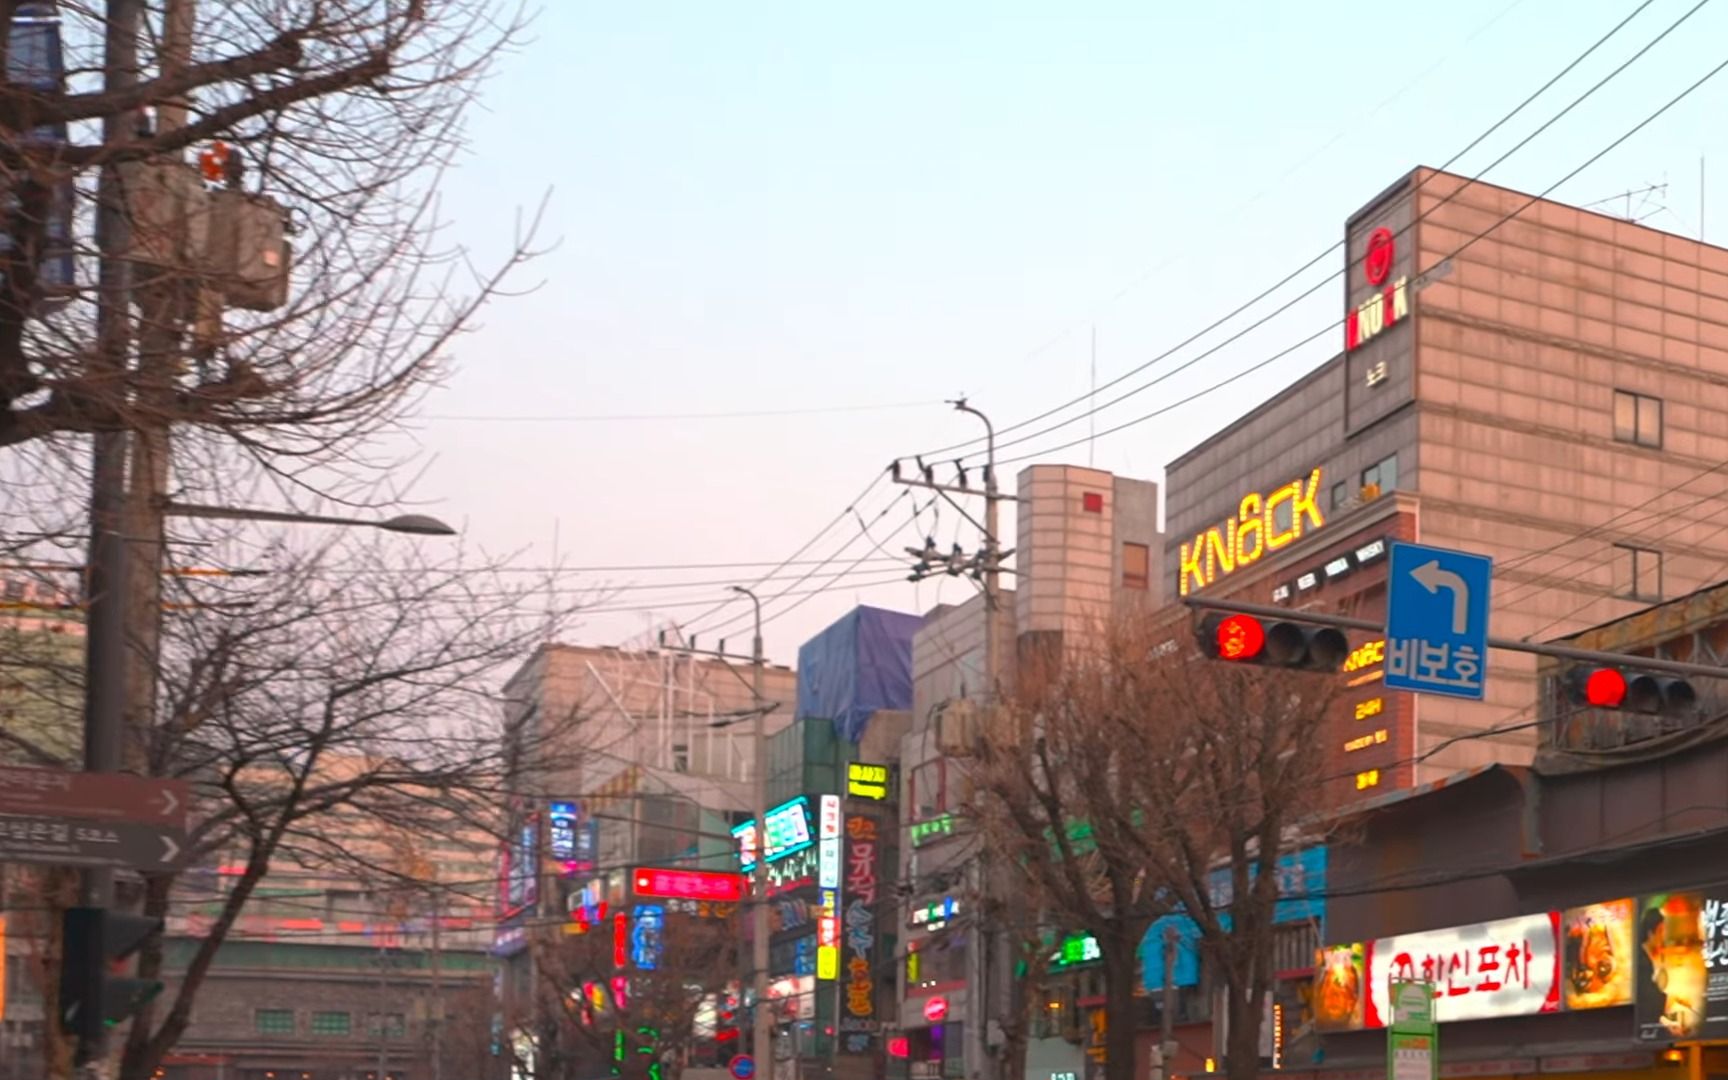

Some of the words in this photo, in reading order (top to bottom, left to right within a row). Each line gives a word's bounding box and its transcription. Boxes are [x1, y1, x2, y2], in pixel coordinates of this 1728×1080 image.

[1179, 467, 1325, 596] KNOCK
[1387, 637, 1480, 689] 비보호
[1420, 938, 1533, 998] 한신포차
